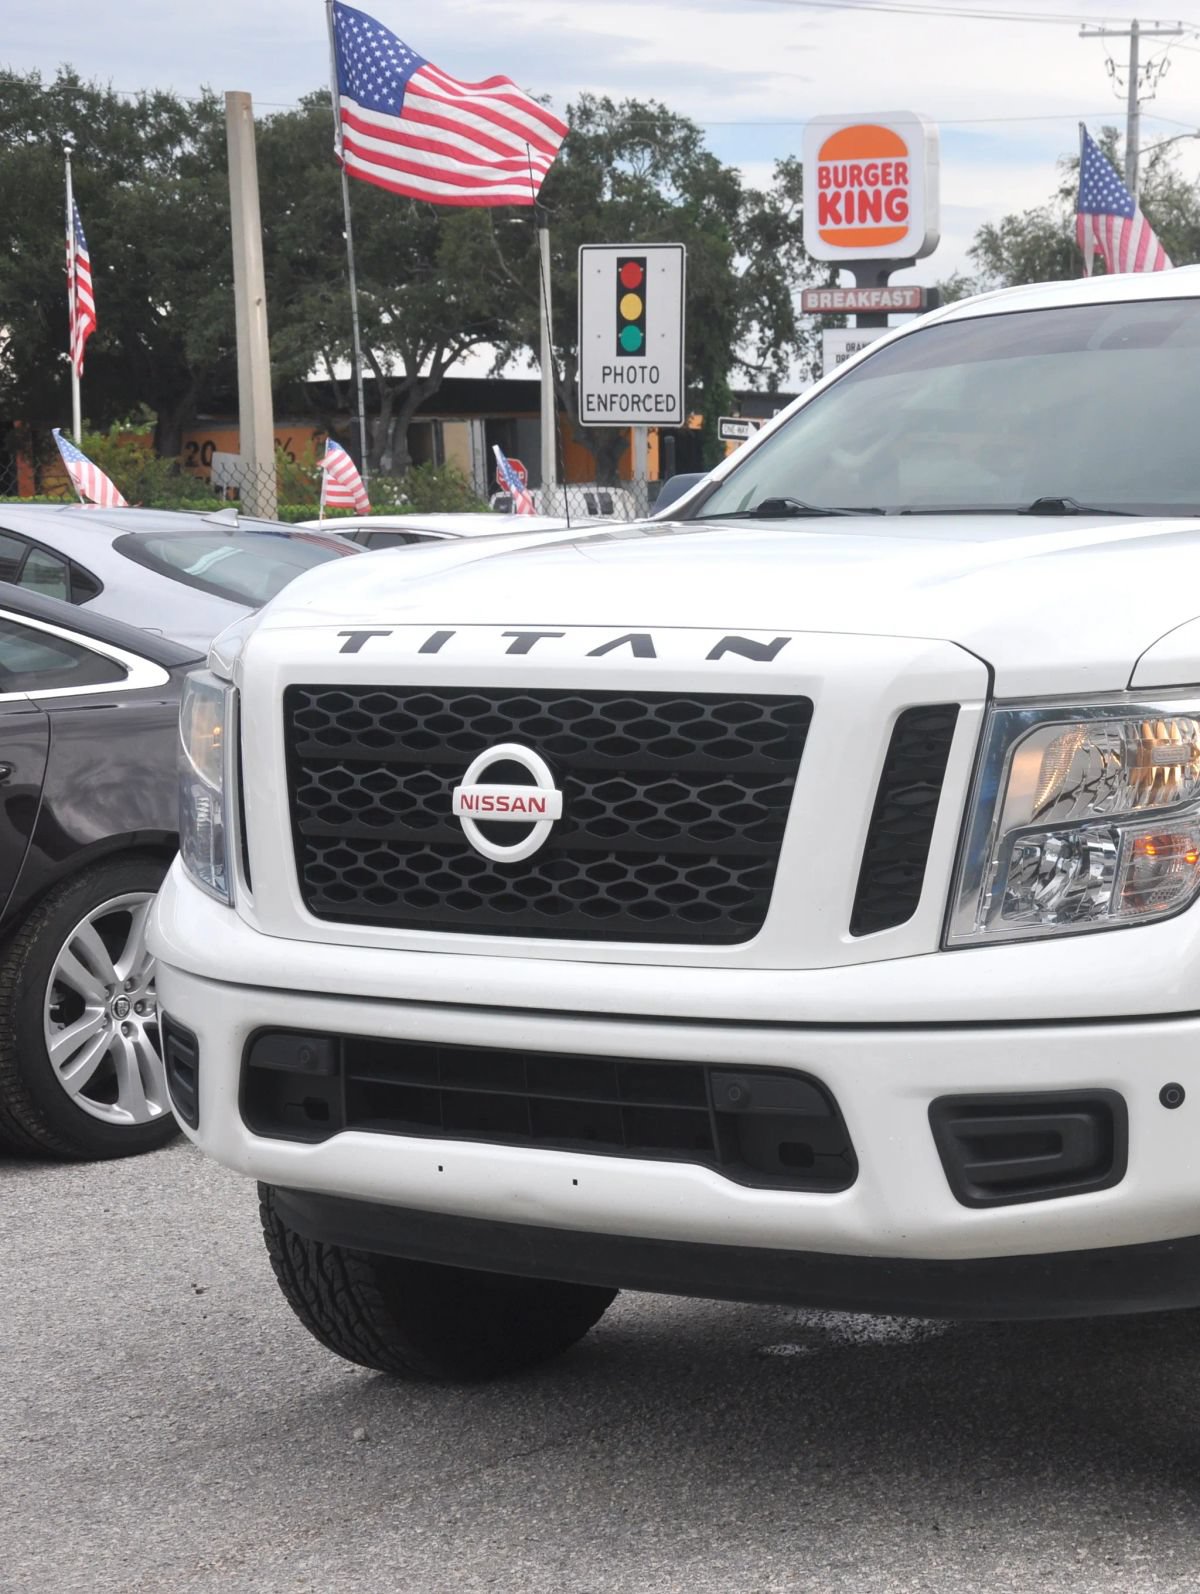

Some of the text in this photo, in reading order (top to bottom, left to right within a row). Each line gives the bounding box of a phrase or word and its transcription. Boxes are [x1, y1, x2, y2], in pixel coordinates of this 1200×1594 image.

[817, 161, 909, 189] BURGER
[818, 187, 909, 226] KING
[807, 289, 914, 309] BREAKFAST
[602, 365, 660, 384] PHOTO
[586, 393, 676, 412] ENFORCED
[337, 631, 792, 662] TITAN
[460, 794, 547, 814] NISSAN
